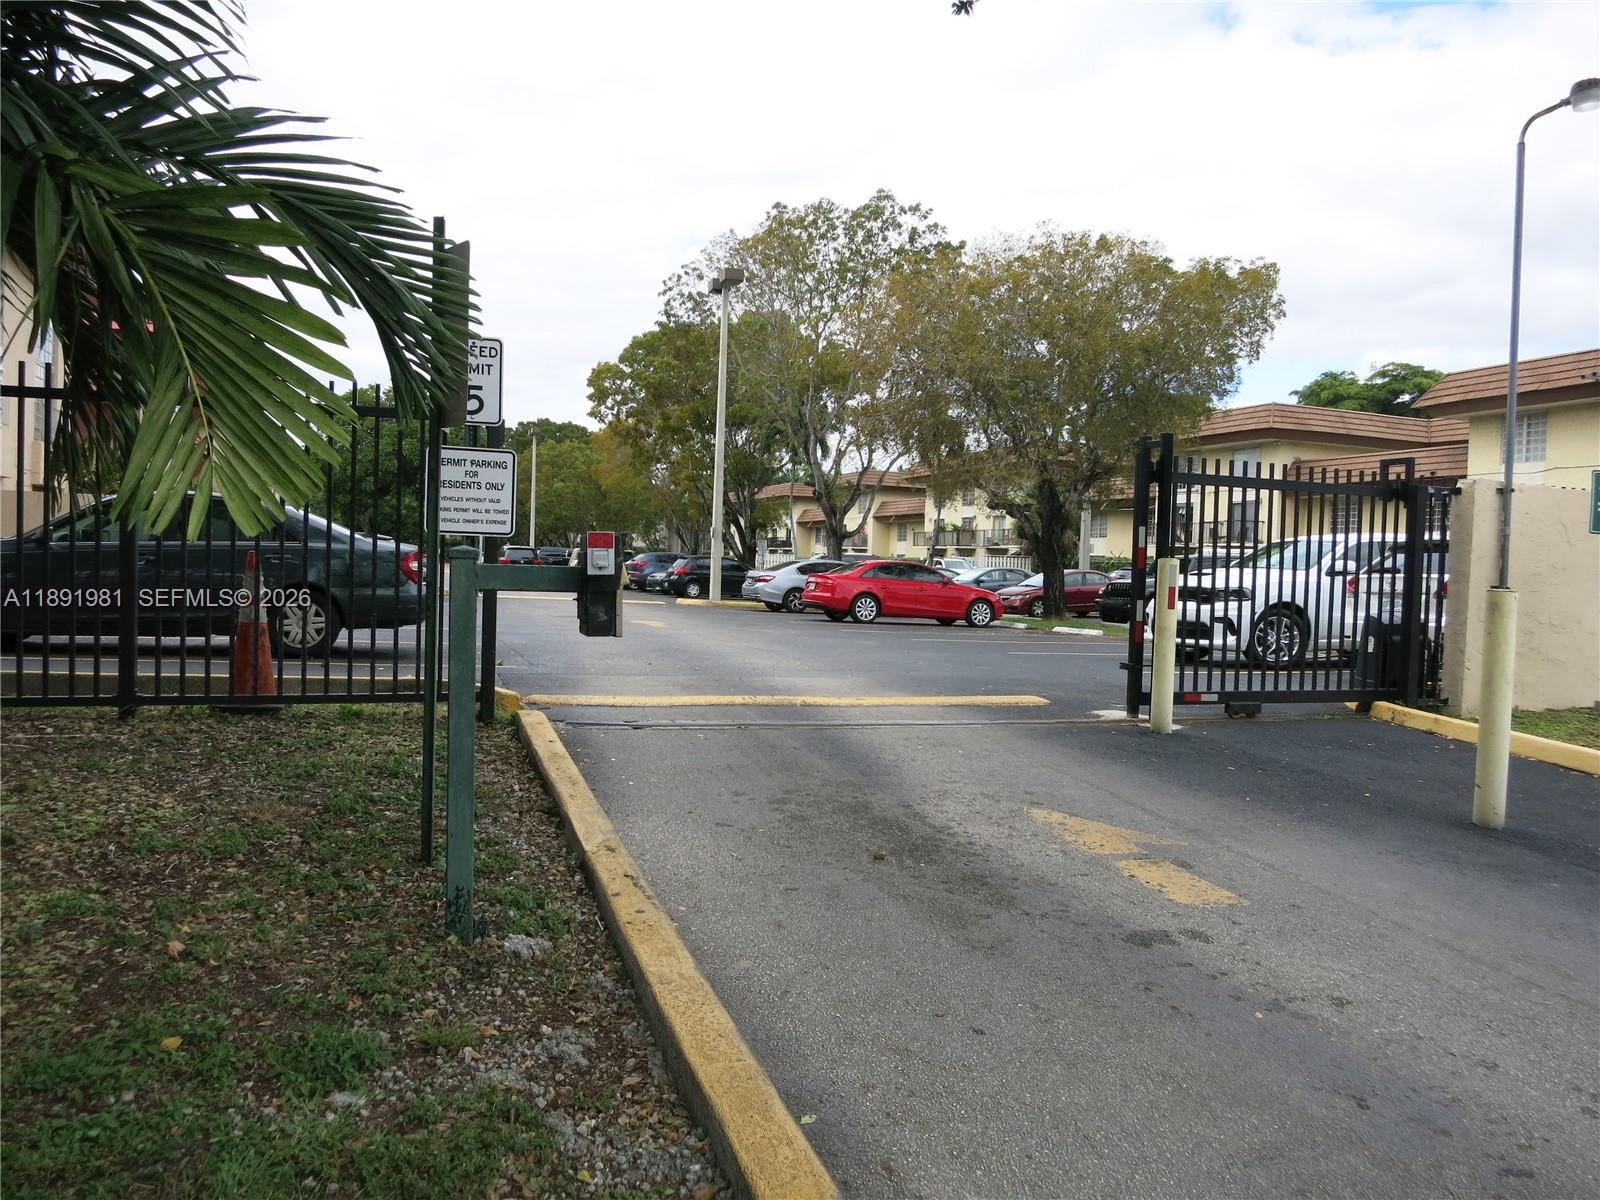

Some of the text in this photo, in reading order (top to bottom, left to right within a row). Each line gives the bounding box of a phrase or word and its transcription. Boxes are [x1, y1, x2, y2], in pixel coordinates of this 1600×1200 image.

[470, 345, 498, 358] EED
[469, 363, 493, 375] MIT
[441, 457, 508, 469] ERMIT PARKING
[464, 470, 479, 478] FOR
[485, 482, 505, 491] ONLY
